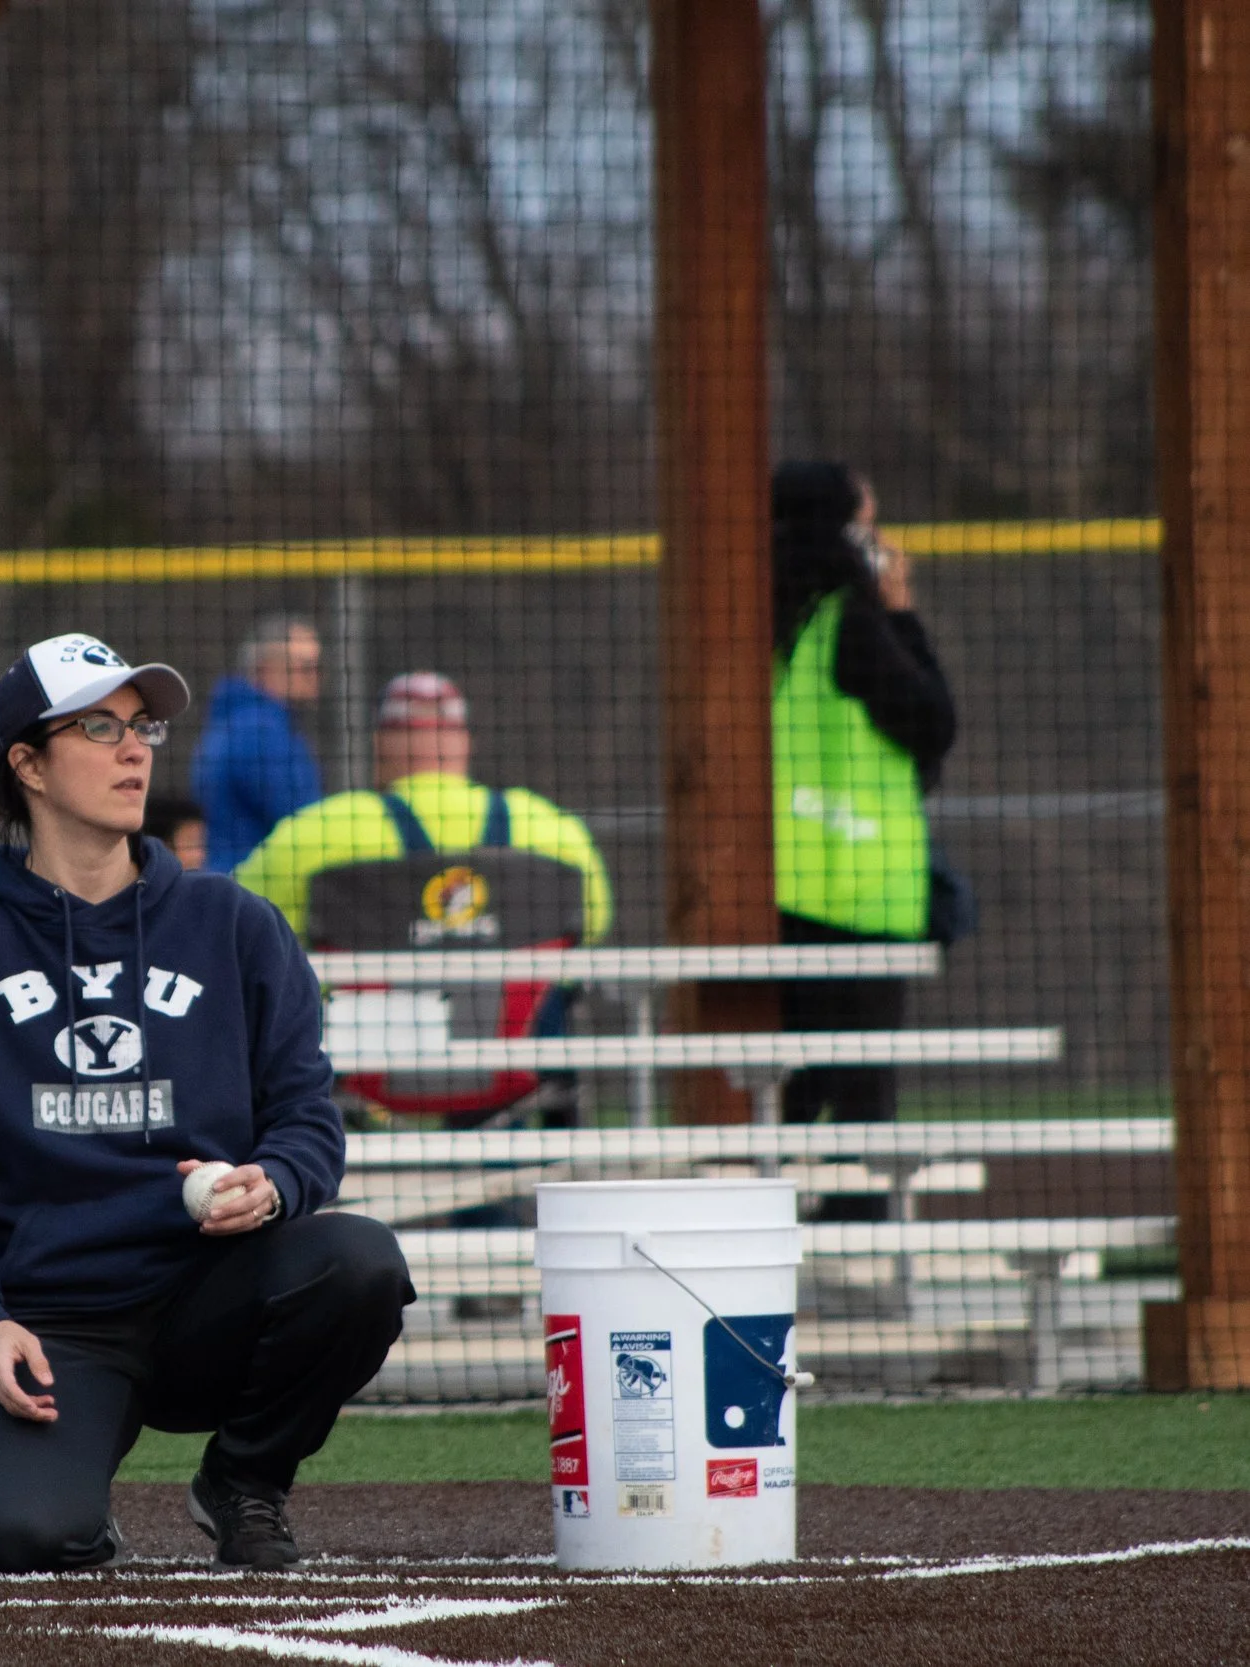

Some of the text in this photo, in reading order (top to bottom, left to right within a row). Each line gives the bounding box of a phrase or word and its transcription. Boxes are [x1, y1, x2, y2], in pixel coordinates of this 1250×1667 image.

[74, 1021, 133, 1070] Y
[40, 1088, 164, 1126] COUGARS
[621, 1334, 669, 1342] WARNING
